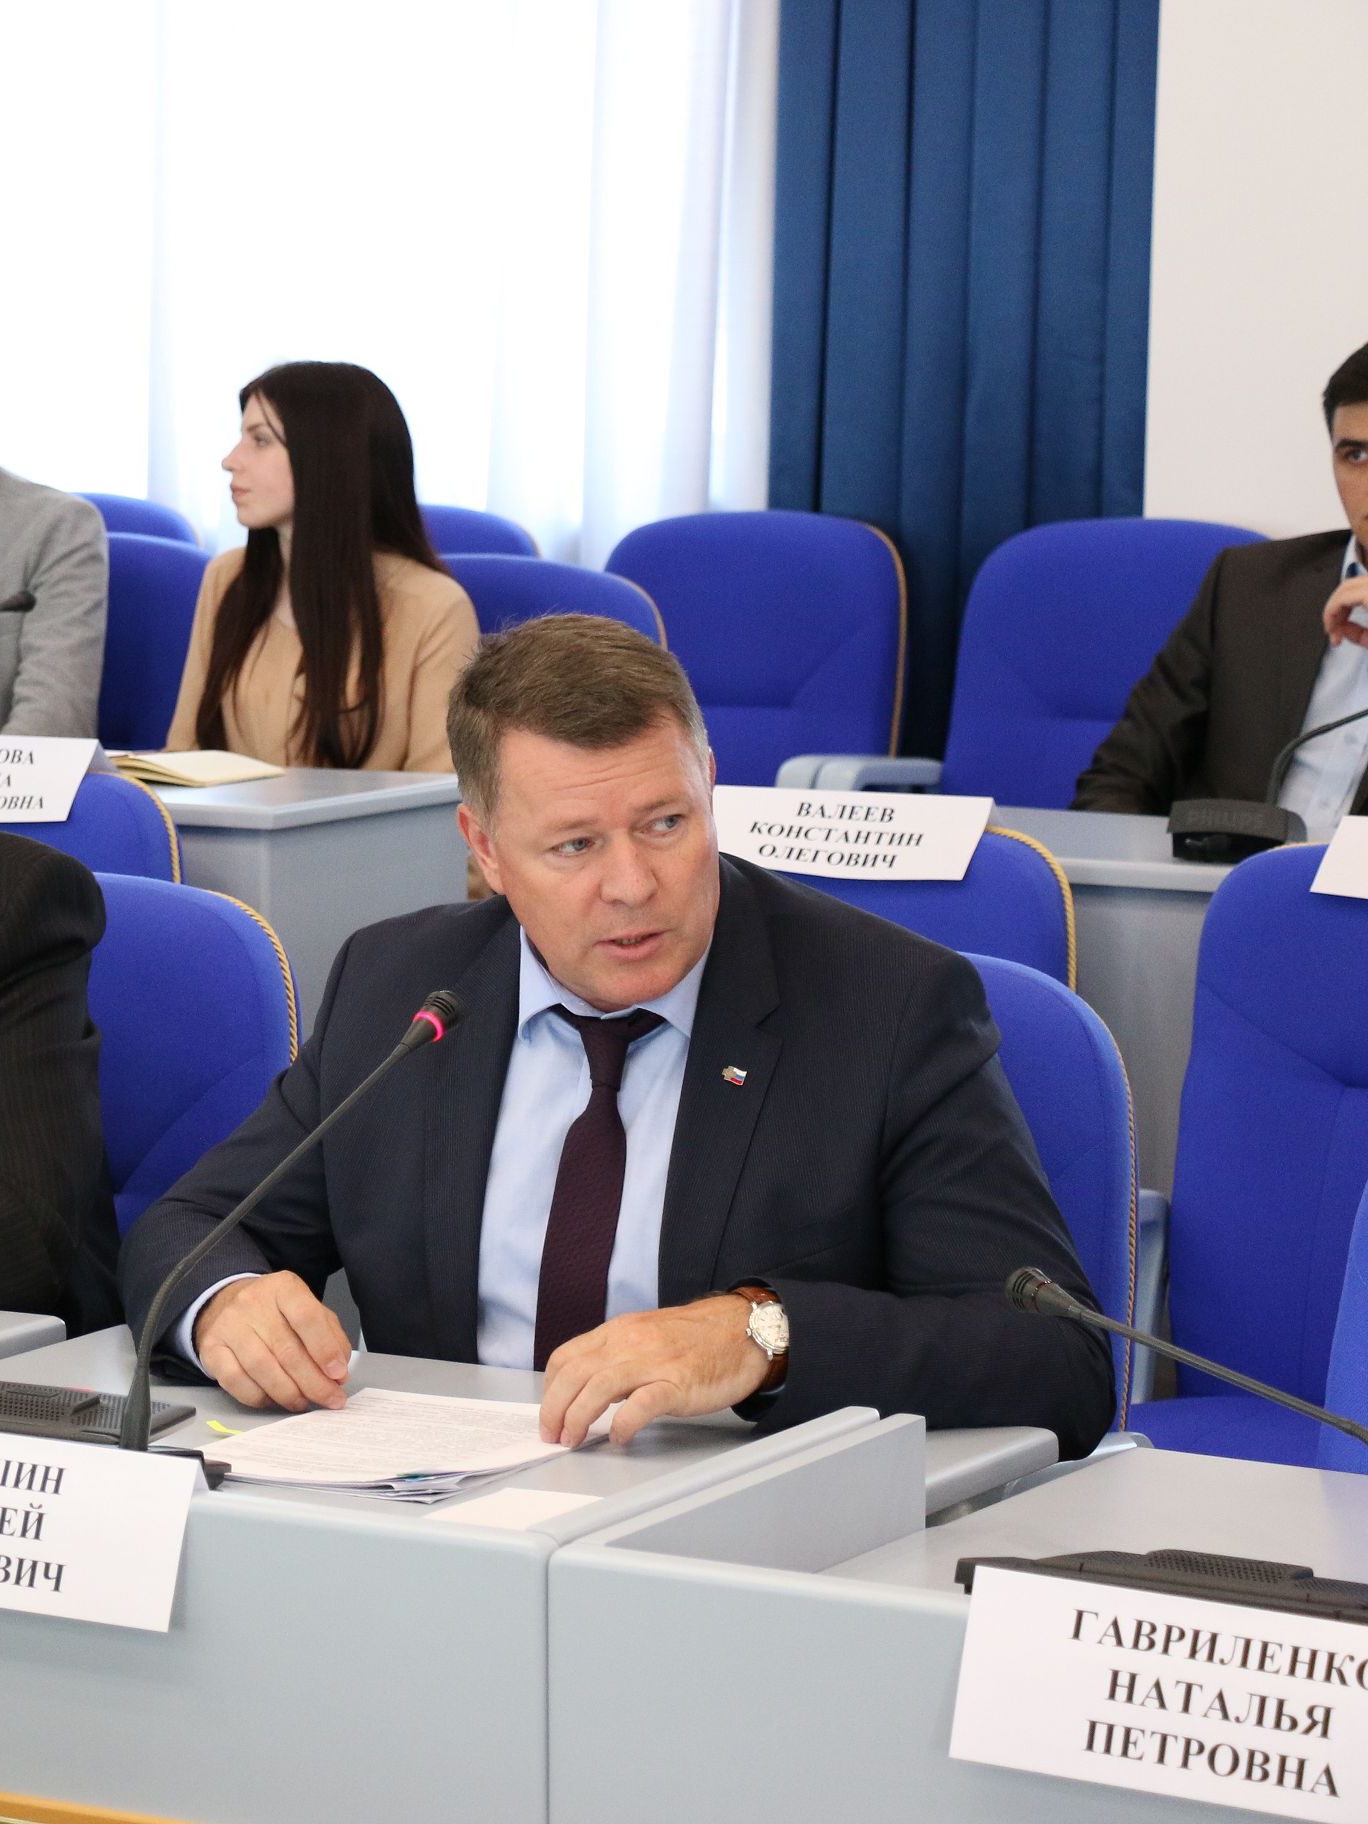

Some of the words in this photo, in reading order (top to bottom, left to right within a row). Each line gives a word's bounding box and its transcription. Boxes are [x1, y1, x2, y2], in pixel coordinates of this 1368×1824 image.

[796, 802, 895, 823] ВАЛЕЕВ
[749, 821, 924, 847] КОНСТАНТИН
[758, 844, 897, 869] ОЛЕГОВИЧ
[1105, 1669, 1336, 1739] НАТАЛЬЯ
[1083, 1720, 1340, 1798] ПЕТРОВНА
